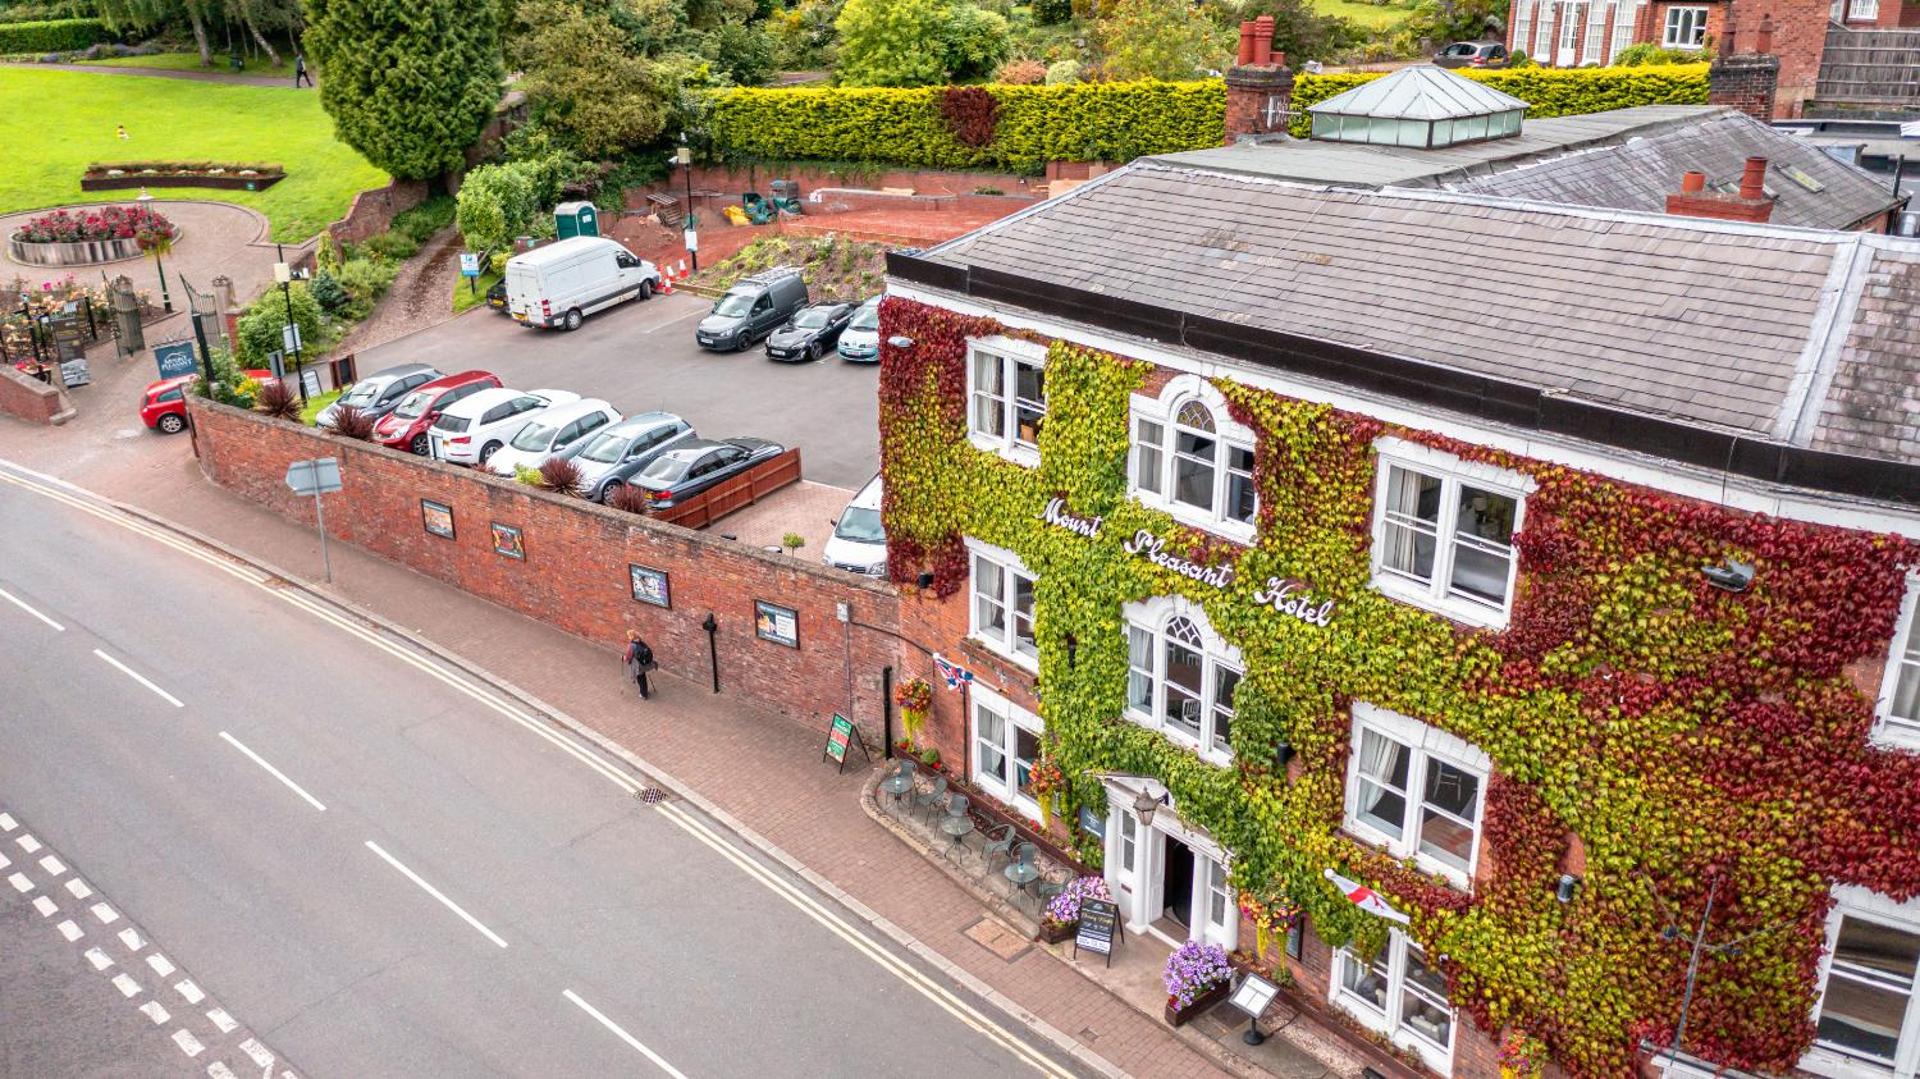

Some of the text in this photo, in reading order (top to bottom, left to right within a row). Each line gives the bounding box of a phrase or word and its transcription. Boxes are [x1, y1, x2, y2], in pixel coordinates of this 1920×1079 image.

[1039, 498, 1334, 627] Mount Pleasant Hotel
